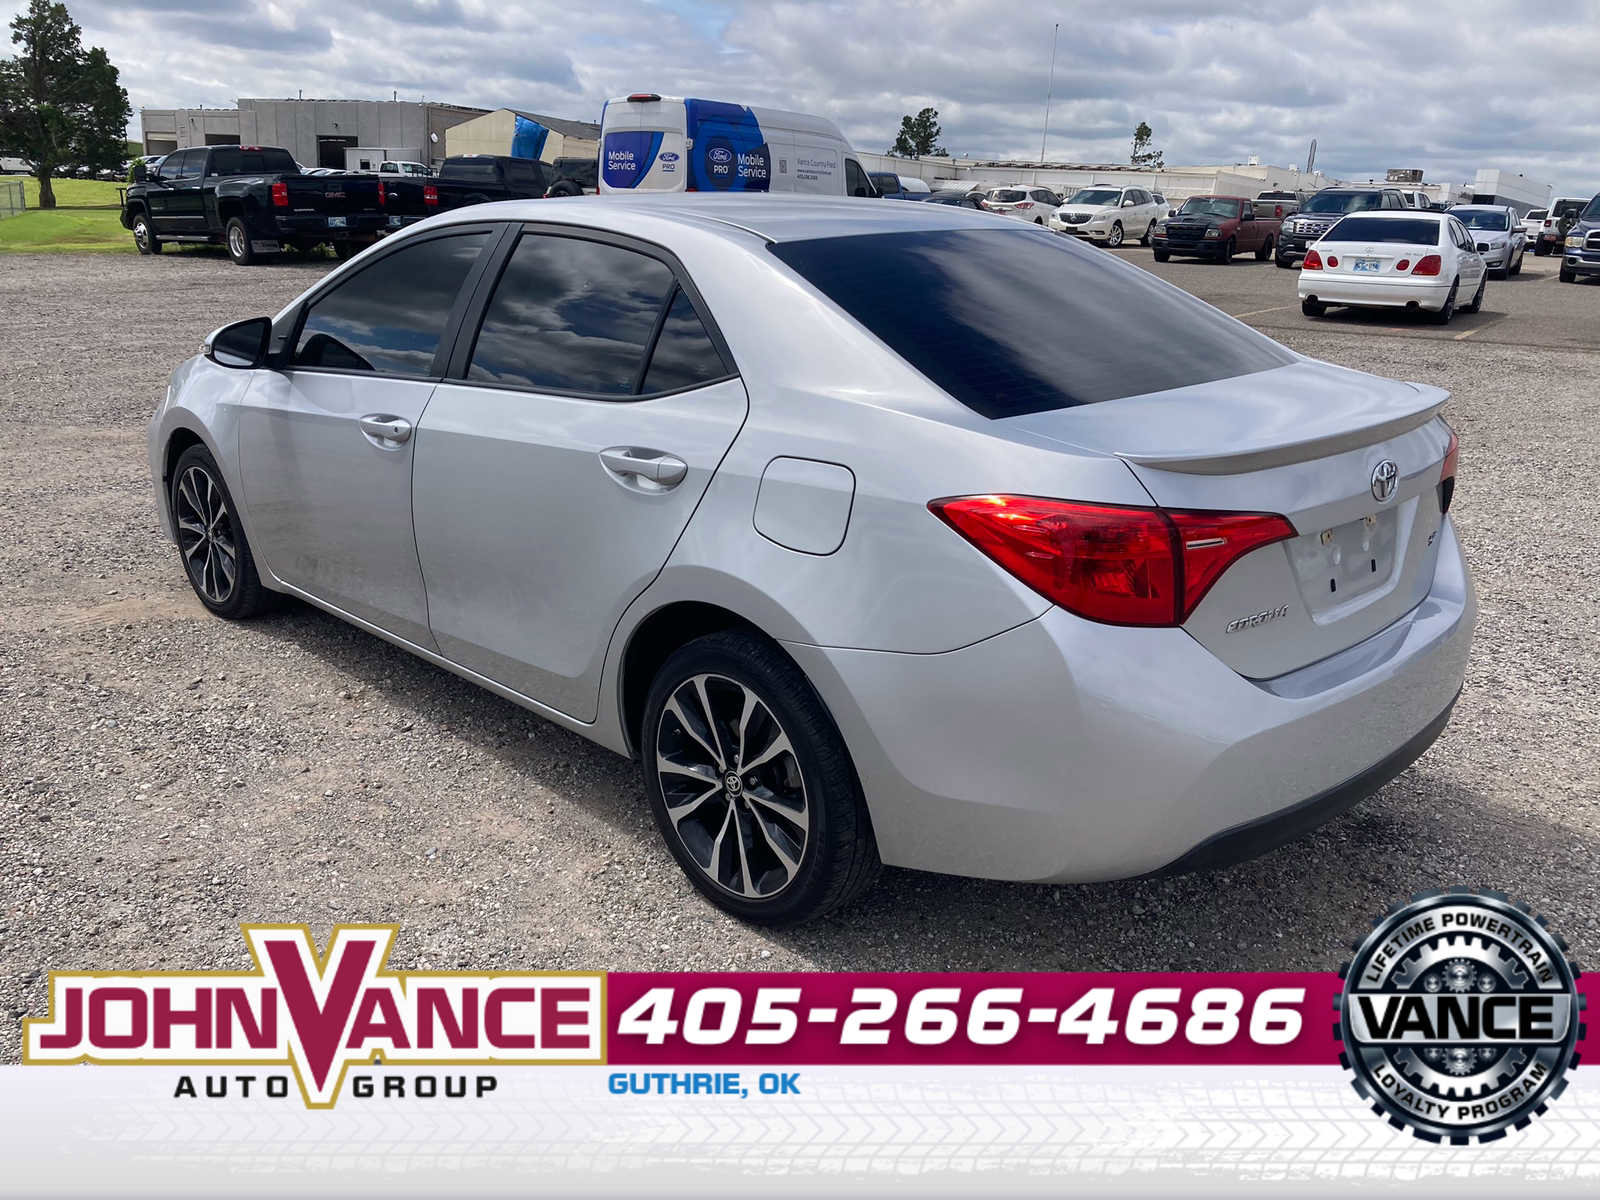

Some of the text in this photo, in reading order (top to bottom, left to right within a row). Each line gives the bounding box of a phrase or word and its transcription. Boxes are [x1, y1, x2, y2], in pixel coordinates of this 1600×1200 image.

[608, 151, 634, 160] Mobile
[711, 149, 730, 161] Ford
[738, 153, 765, 166] Mobile
[608, 161, 636, 170] Service
[713, 165, 729, 174] PRO
[738, 166, 767, 178] Service
